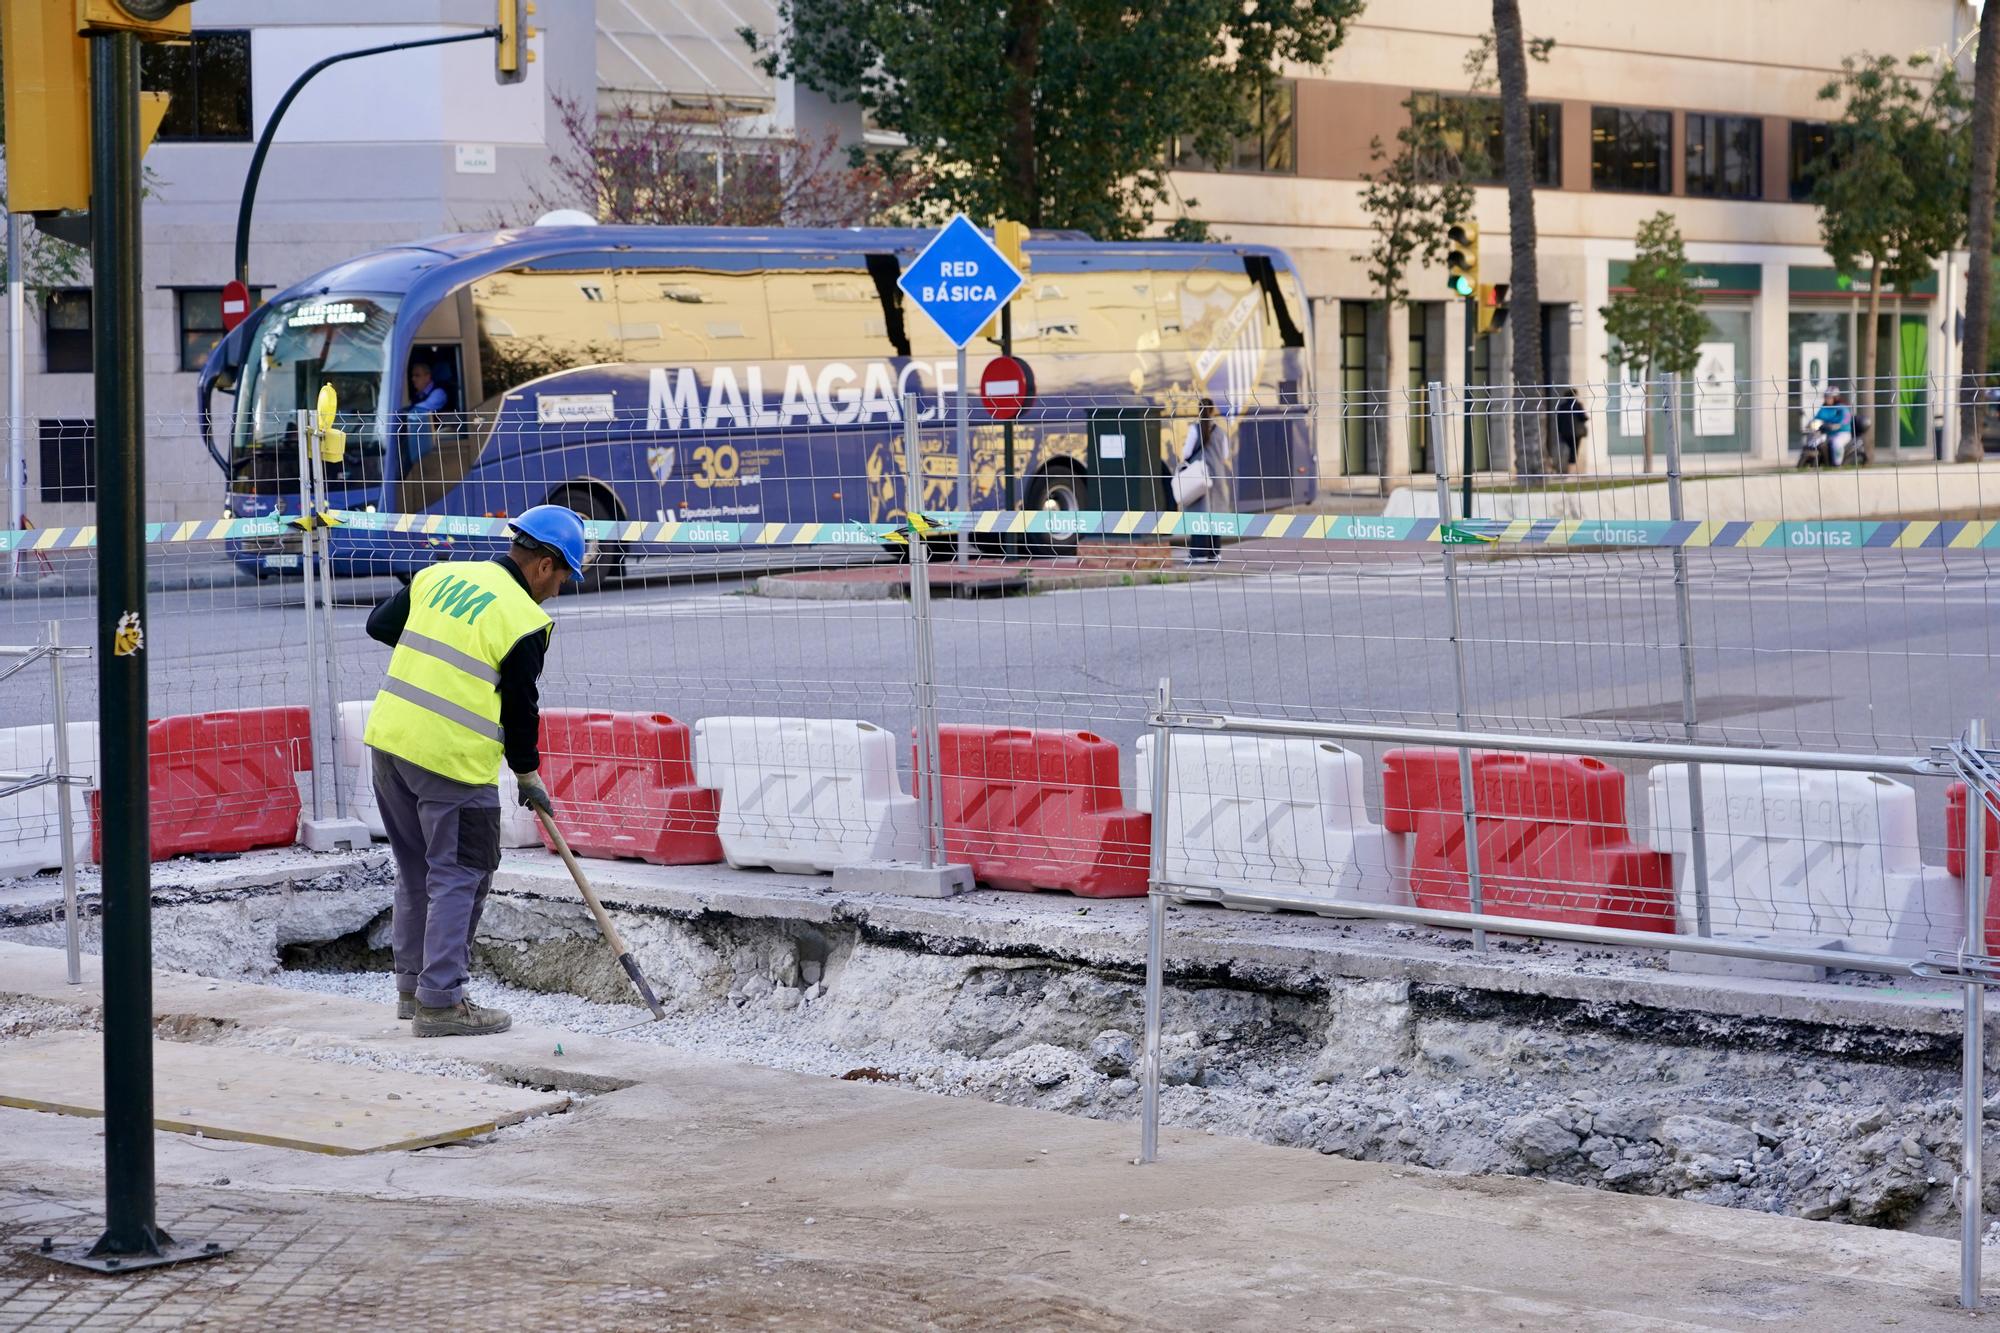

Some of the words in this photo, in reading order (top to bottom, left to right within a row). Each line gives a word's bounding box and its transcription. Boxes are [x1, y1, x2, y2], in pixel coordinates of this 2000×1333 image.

[940, 262, 978, 277] RED
[922, 281, 997, 302] BÁSICA
[692, 445, 739, 488] 30
